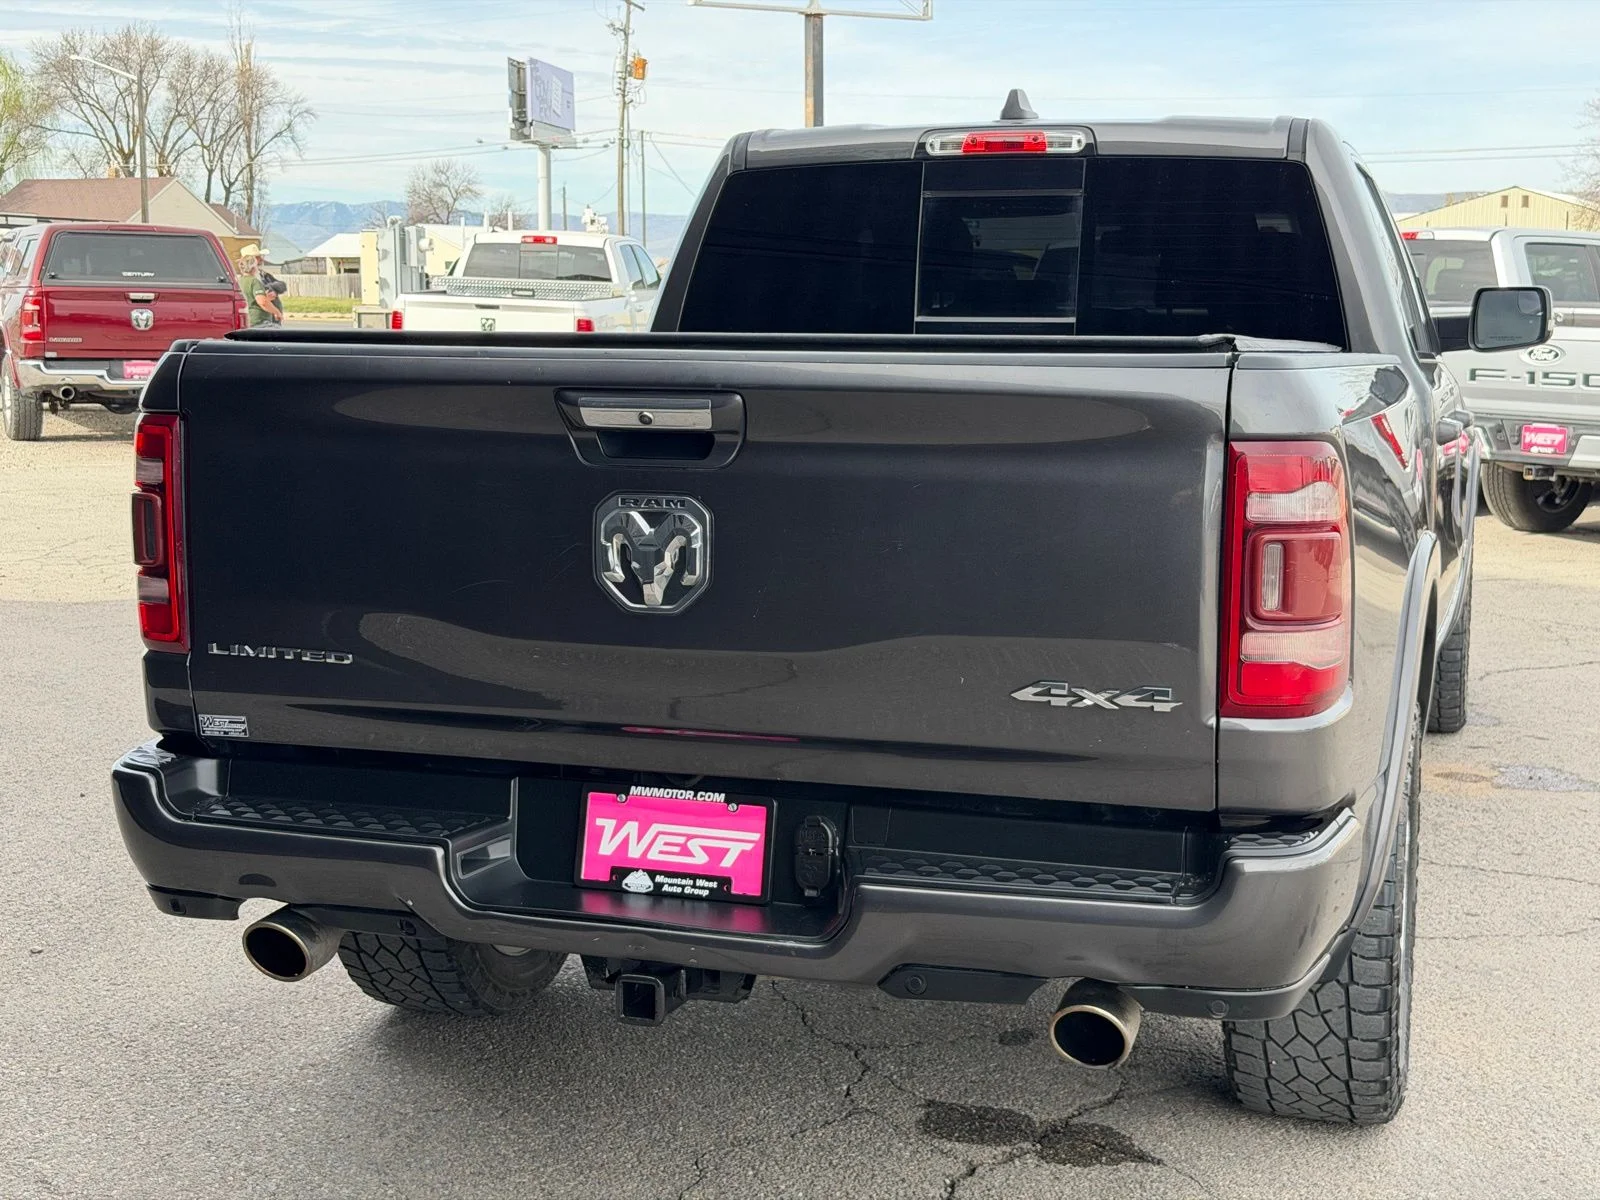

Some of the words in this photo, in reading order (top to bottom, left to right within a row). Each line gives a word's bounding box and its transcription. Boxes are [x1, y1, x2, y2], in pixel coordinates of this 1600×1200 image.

[1530, 347, 1558, 361] Ford
[618, 496, 686, 509] RAM
[207, 642, 354, 665] LIMITED
[629, 785, 726, 803] MWMOTOR.COM
[595, 817, 761, 868] WEST
[655, 874, 694, 886] Mountain
[695, 878, 718, 888] West
[661, 884, 683, 893] Auto
[683, 886, 710, 897] Group
